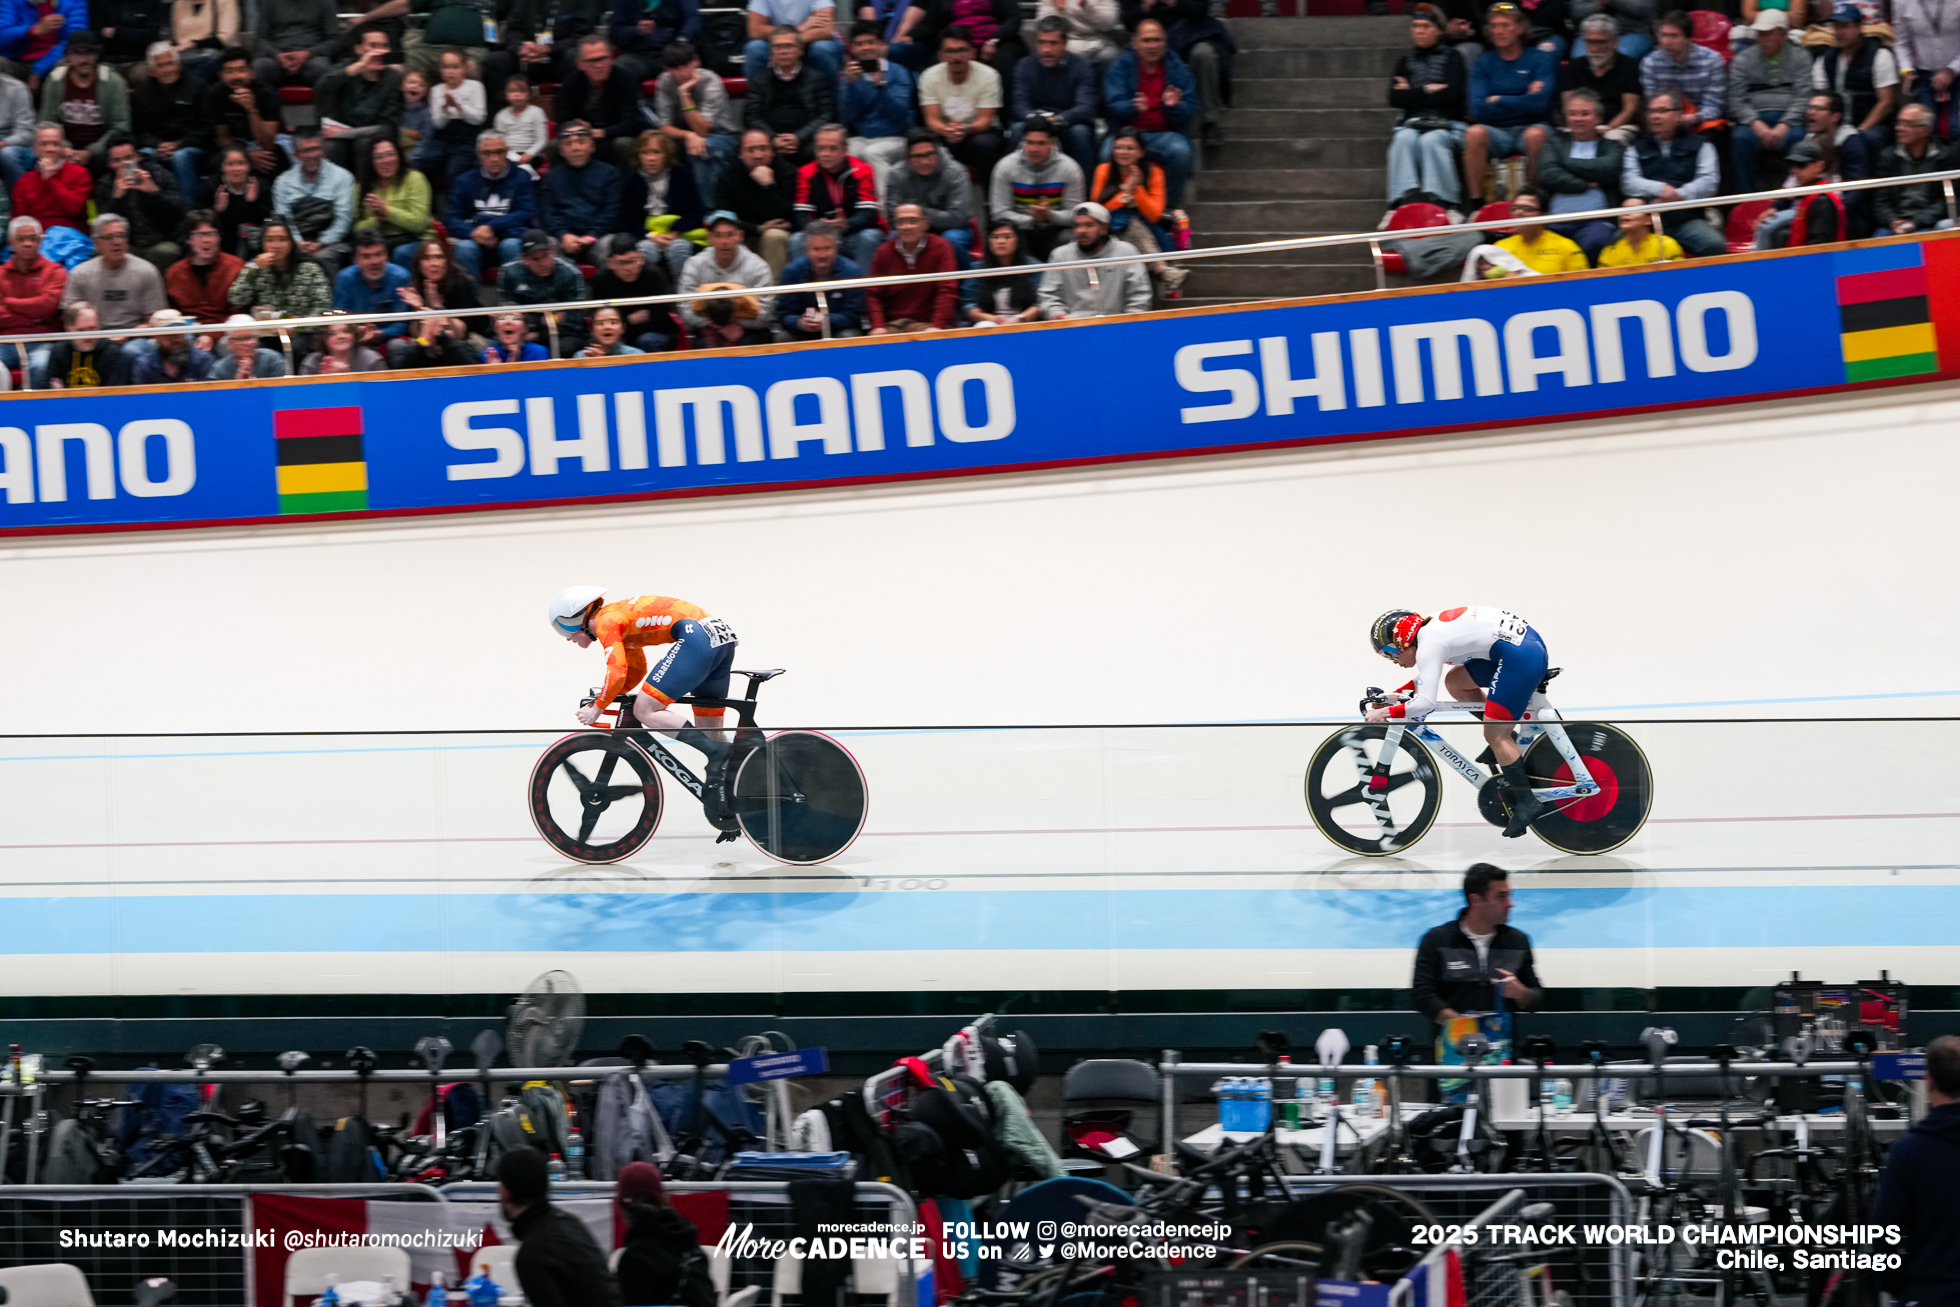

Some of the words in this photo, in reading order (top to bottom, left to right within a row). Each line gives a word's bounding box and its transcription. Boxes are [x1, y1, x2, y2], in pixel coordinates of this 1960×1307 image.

[1173, 289, 1760, 426] SHIMANO
[441, 360, 1017, 482] SHIMANO
[1489, 658, 1504, 696] JAPAN
[646, 743, 704, 798] KOGA
[1439, 744, 1480, 782] TORAYCA
